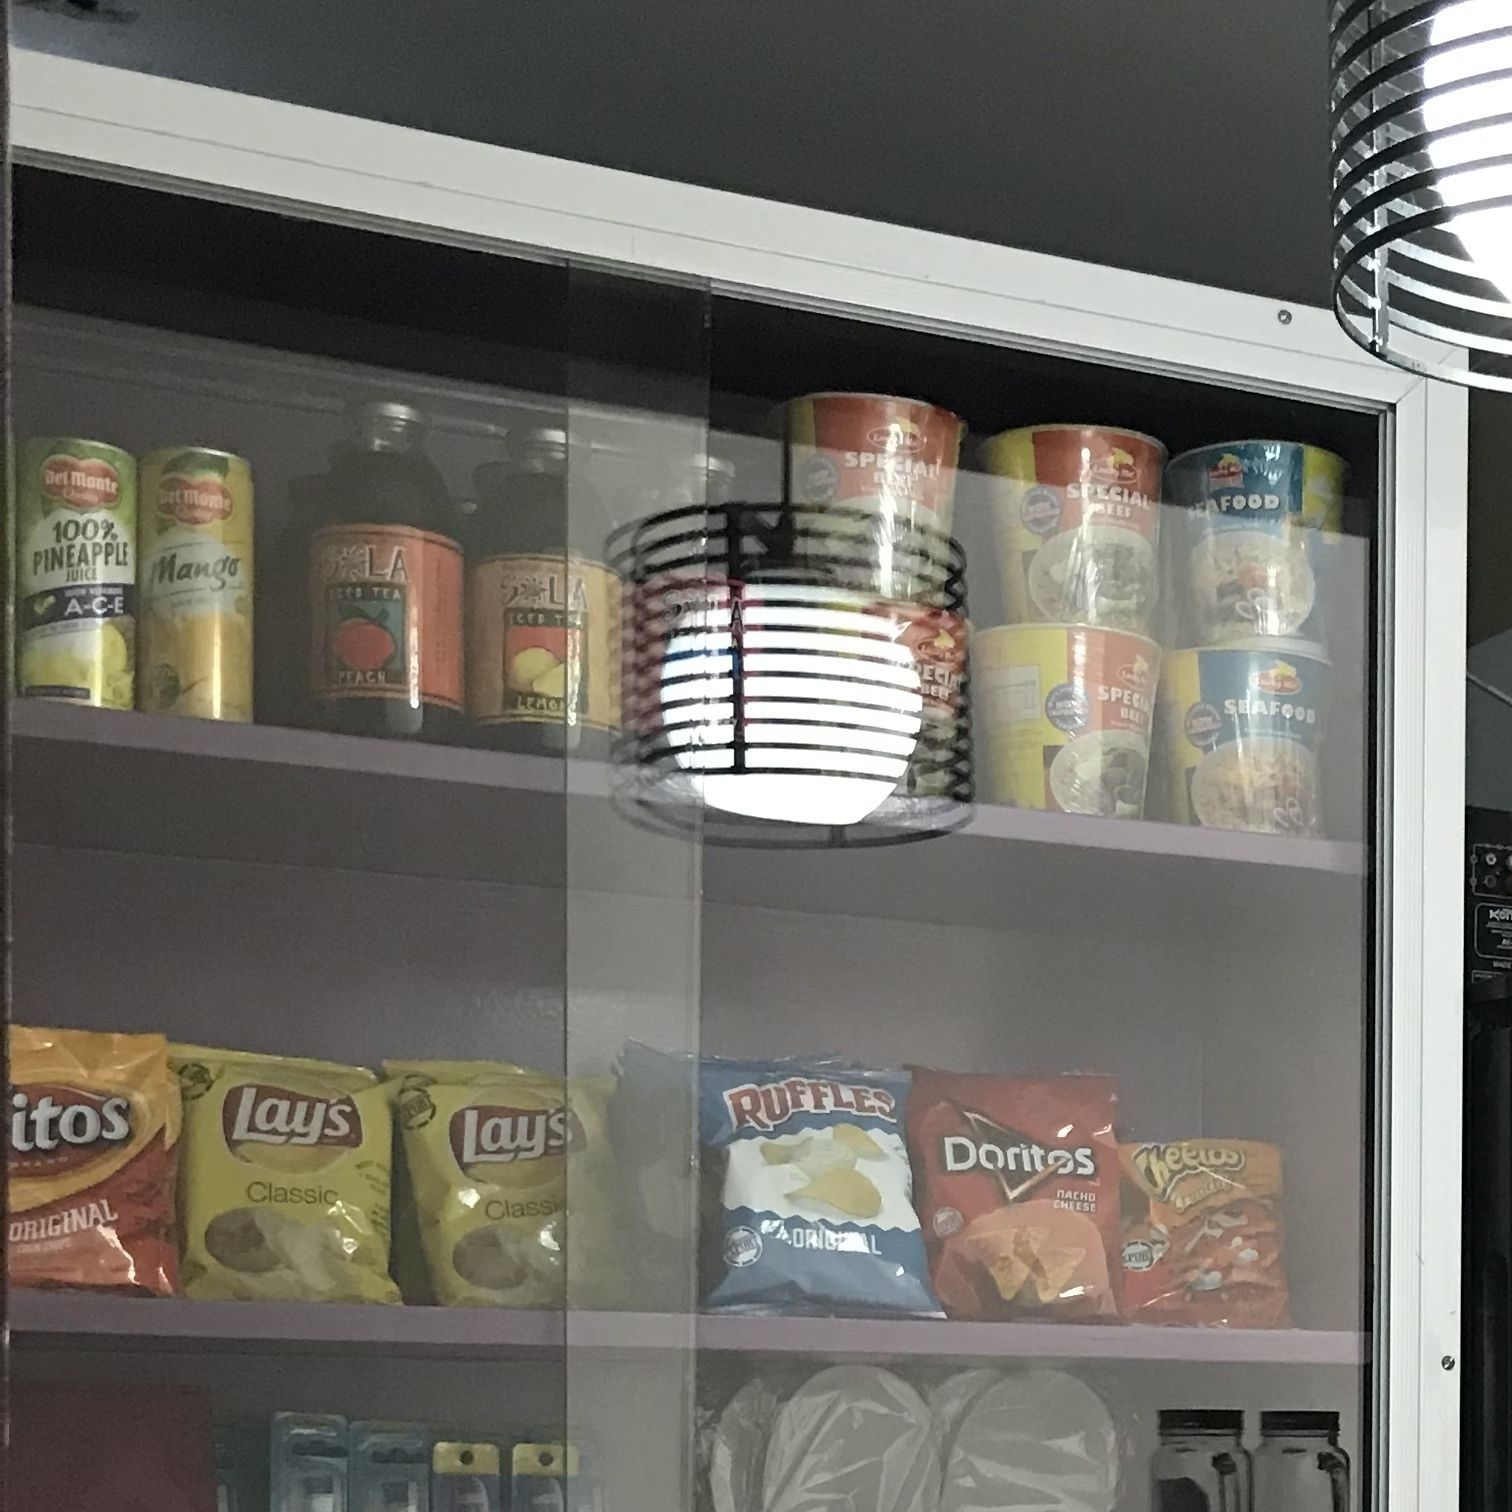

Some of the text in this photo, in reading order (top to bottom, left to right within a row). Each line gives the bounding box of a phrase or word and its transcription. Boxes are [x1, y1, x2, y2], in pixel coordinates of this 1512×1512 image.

[71, 472, 118, 493] Monte
[52, 518, 118, 544] 100%
[33, 542, 129, 577] PINEAPPLE
[158, 552, 241, 592] Mango
[65, 567, 98, 583] JUICE
[64, 596, 125, 617] A-C-E
[1224, 698, 1316, 725] SEAFOOD
[724, 1076, 898, 1132] RUFFLES
[11, 1092, 130, 1152] itos
[943, 1135, 1096, 1176] Doritos
[1131, 1144, 1244, 1200] Cheetos
[246, 1180, 339, 1205] Classic
[1053, 1199, 1097, 1213] CHEESE
[1056, 1188, 1097, 1202] NACHO
[8, 1198, 119, 1242] ORIGINAL
